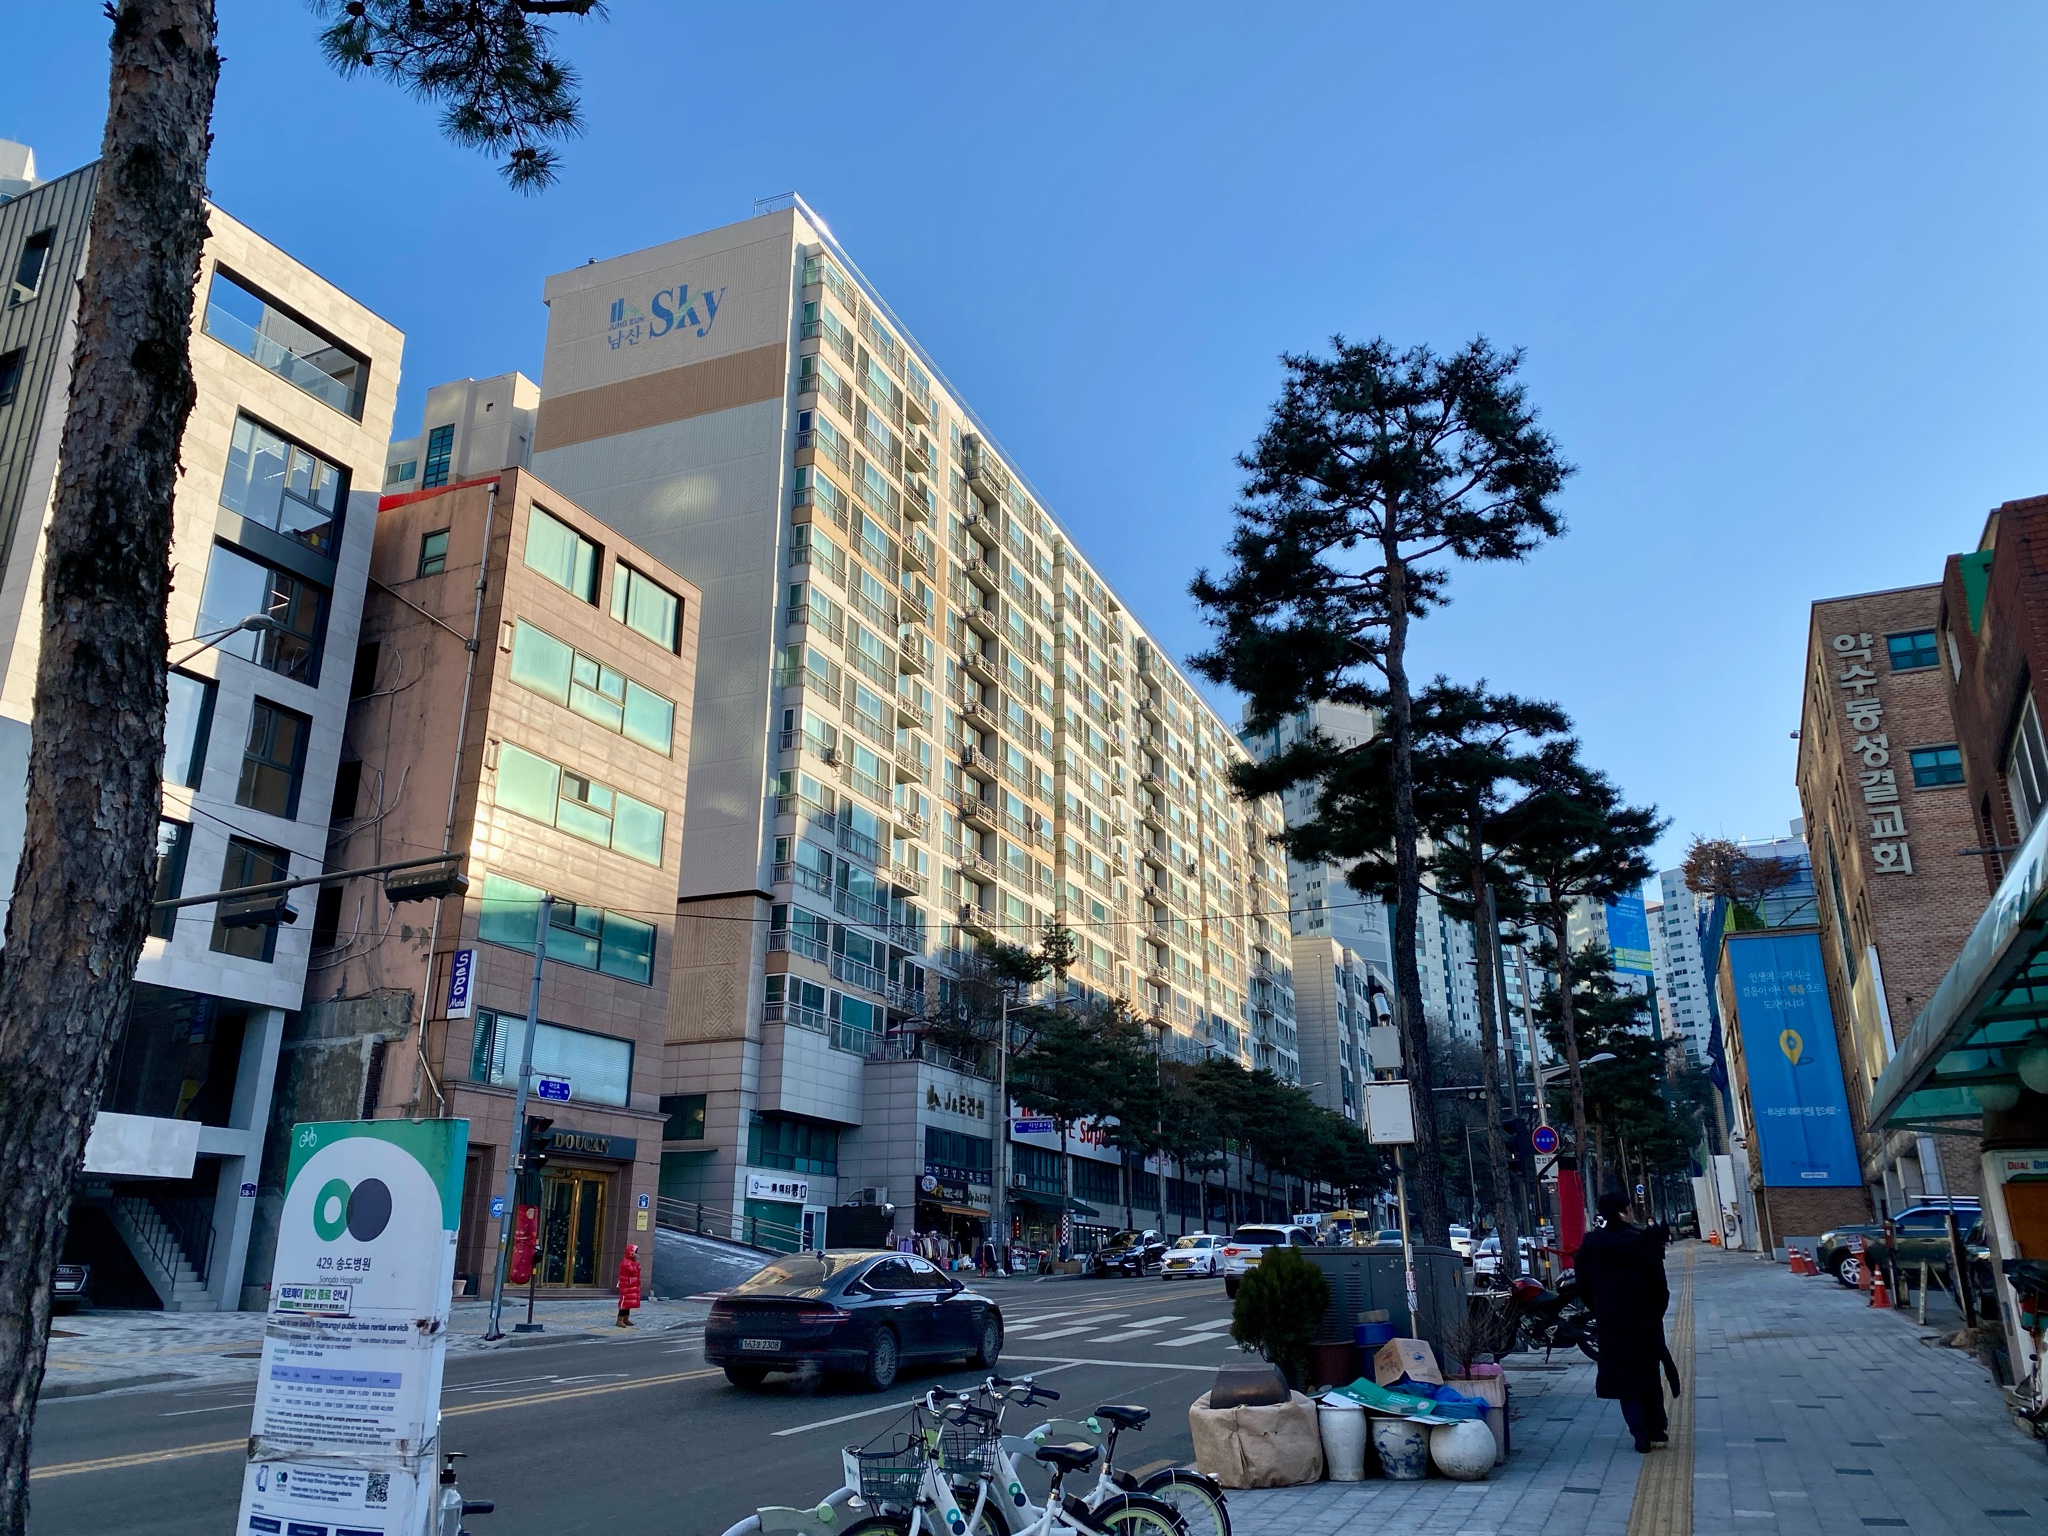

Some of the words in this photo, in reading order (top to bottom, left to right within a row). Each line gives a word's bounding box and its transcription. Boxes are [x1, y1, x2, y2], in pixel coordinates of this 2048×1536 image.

[649, 284, 727, 338] Sky
[608, 321, 627, 331] JUNG
[630, 316, 645, 326] EUN
[608, 325, 643, 350] 남산
[1833, 632, 1913, 875] 약수동성결교회
[453, 952, 469, 996] Sepo
[1749, 970, 1775, 982] 인생의
[1742, 985, 1767, 997] 걸음이
[1769, 985, 1787, 996] 아닌
[448, 996, 466, 1009] Motel
[554, 1132, 610, 1153] DOUCAN
[316, 1257, 334, 1269] 429.
[336, 1257, 371, 1271] 송도병원
[318, 1275, 340, 1284] Songdo
[340, 1276, 363, 1285] Hospital
[333, 1289, 348, 1301] 안내
[762, 1340, 780, 1350] 2308
